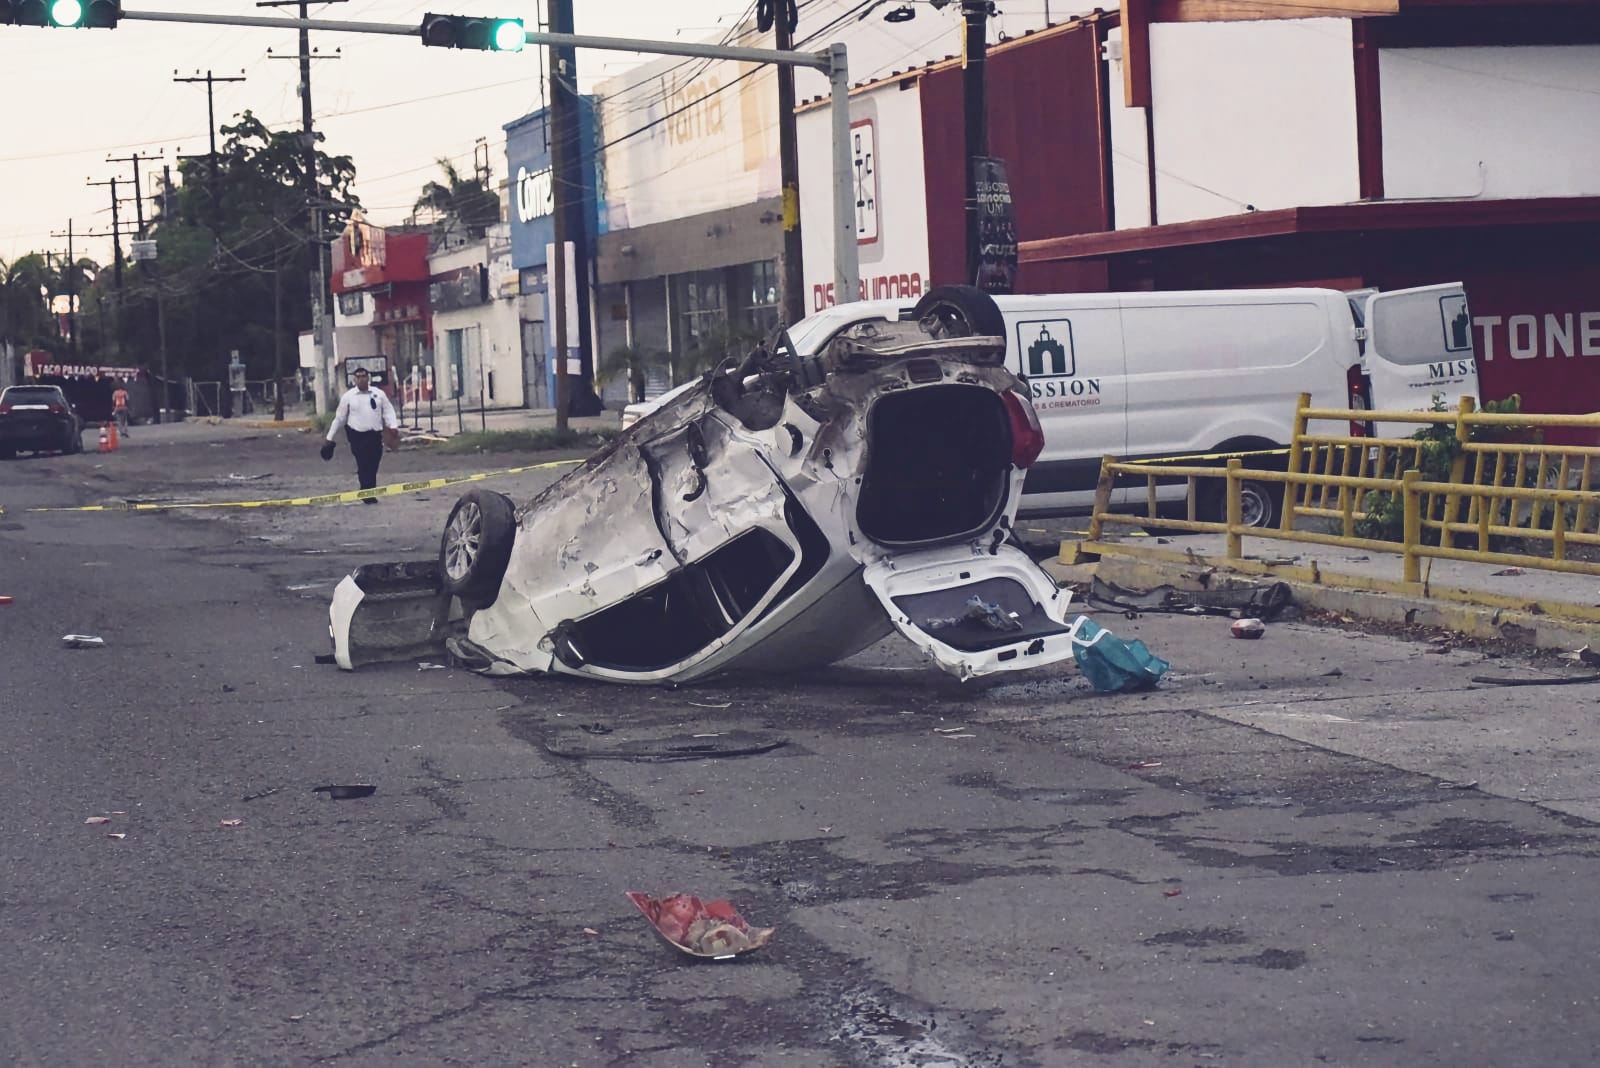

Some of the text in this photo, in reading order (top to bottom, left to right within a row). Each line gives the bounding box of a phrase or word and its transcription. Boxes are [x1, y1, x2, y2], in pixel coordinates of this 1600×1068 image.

[516, 164, 555, 223] Come
[1032, 378, 1101, 398] SSION
[1049, 398, 1101, 408] CREMATORIO
